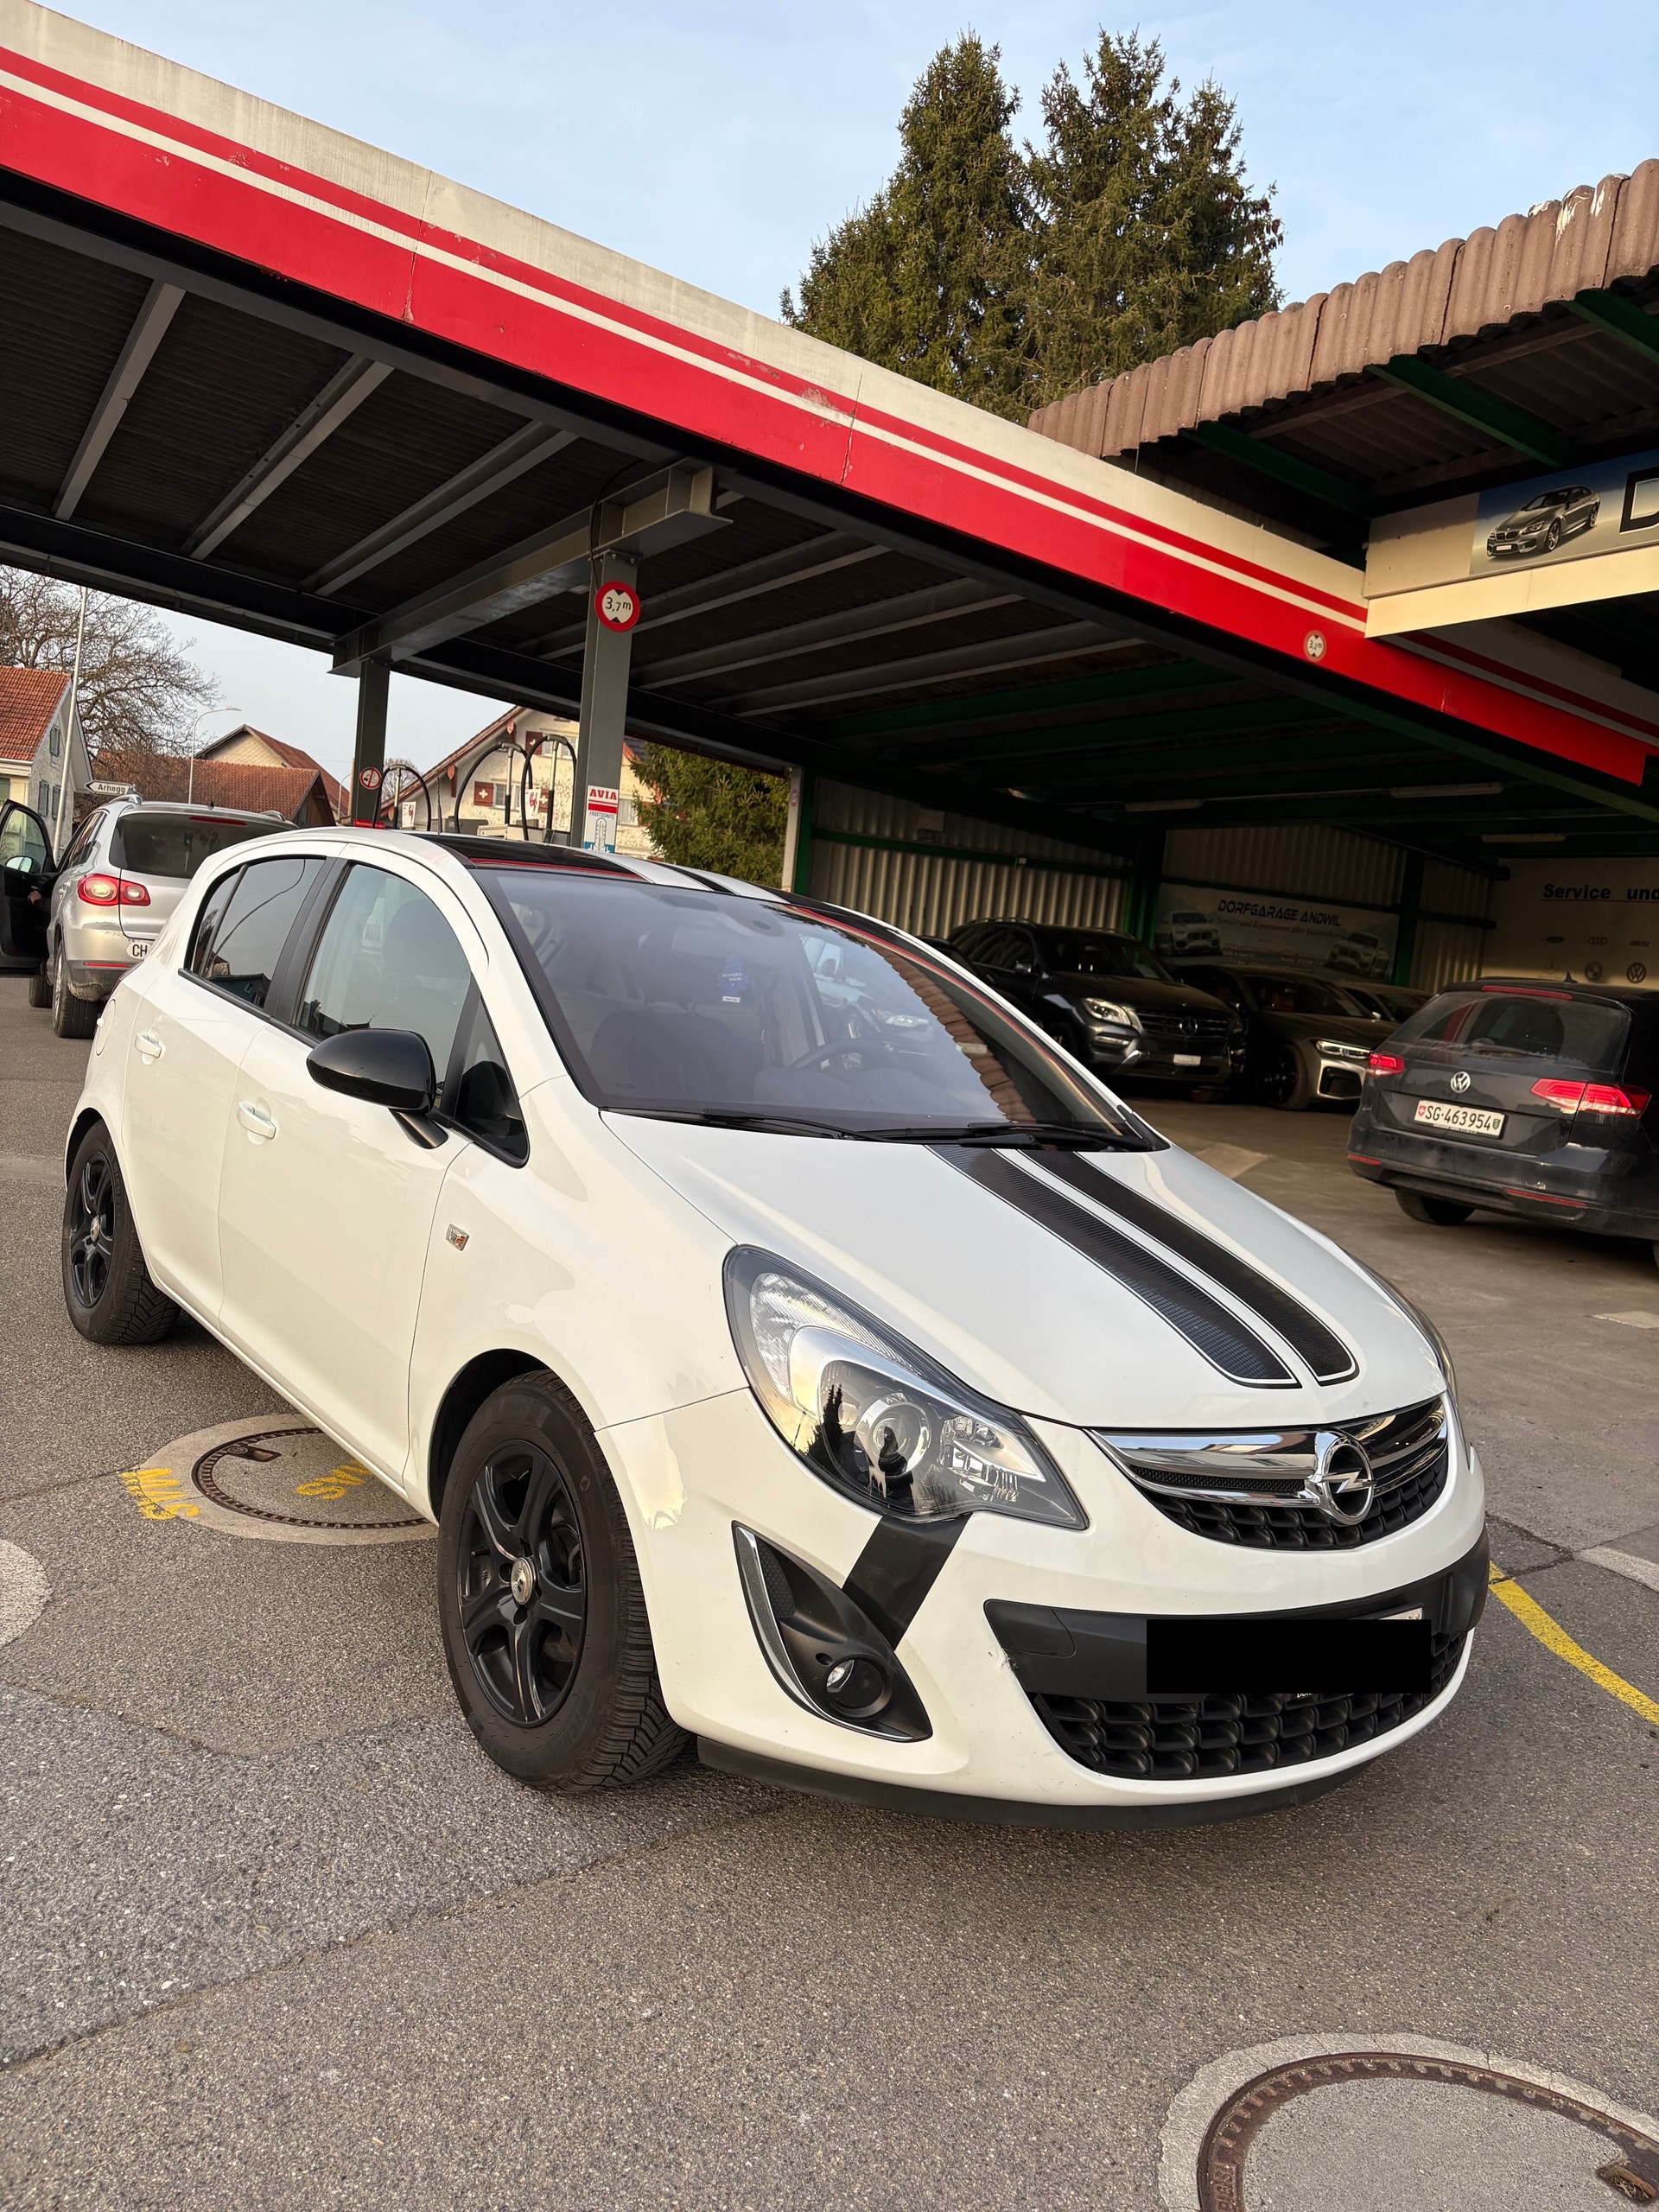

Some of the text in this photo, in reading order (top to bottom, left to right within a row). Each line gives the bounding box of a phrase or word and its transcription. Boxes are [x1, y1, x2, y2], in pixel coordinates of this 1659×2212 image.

[98, 784, 125, 795] Arnegg
[589, 788, 617, 800] AVIA
[1542, 883, 1611, 899] Service
[1217, 899, 1341, 927] DORFGARAGE ANDWIL
[132, 944, 148, 957] CH
